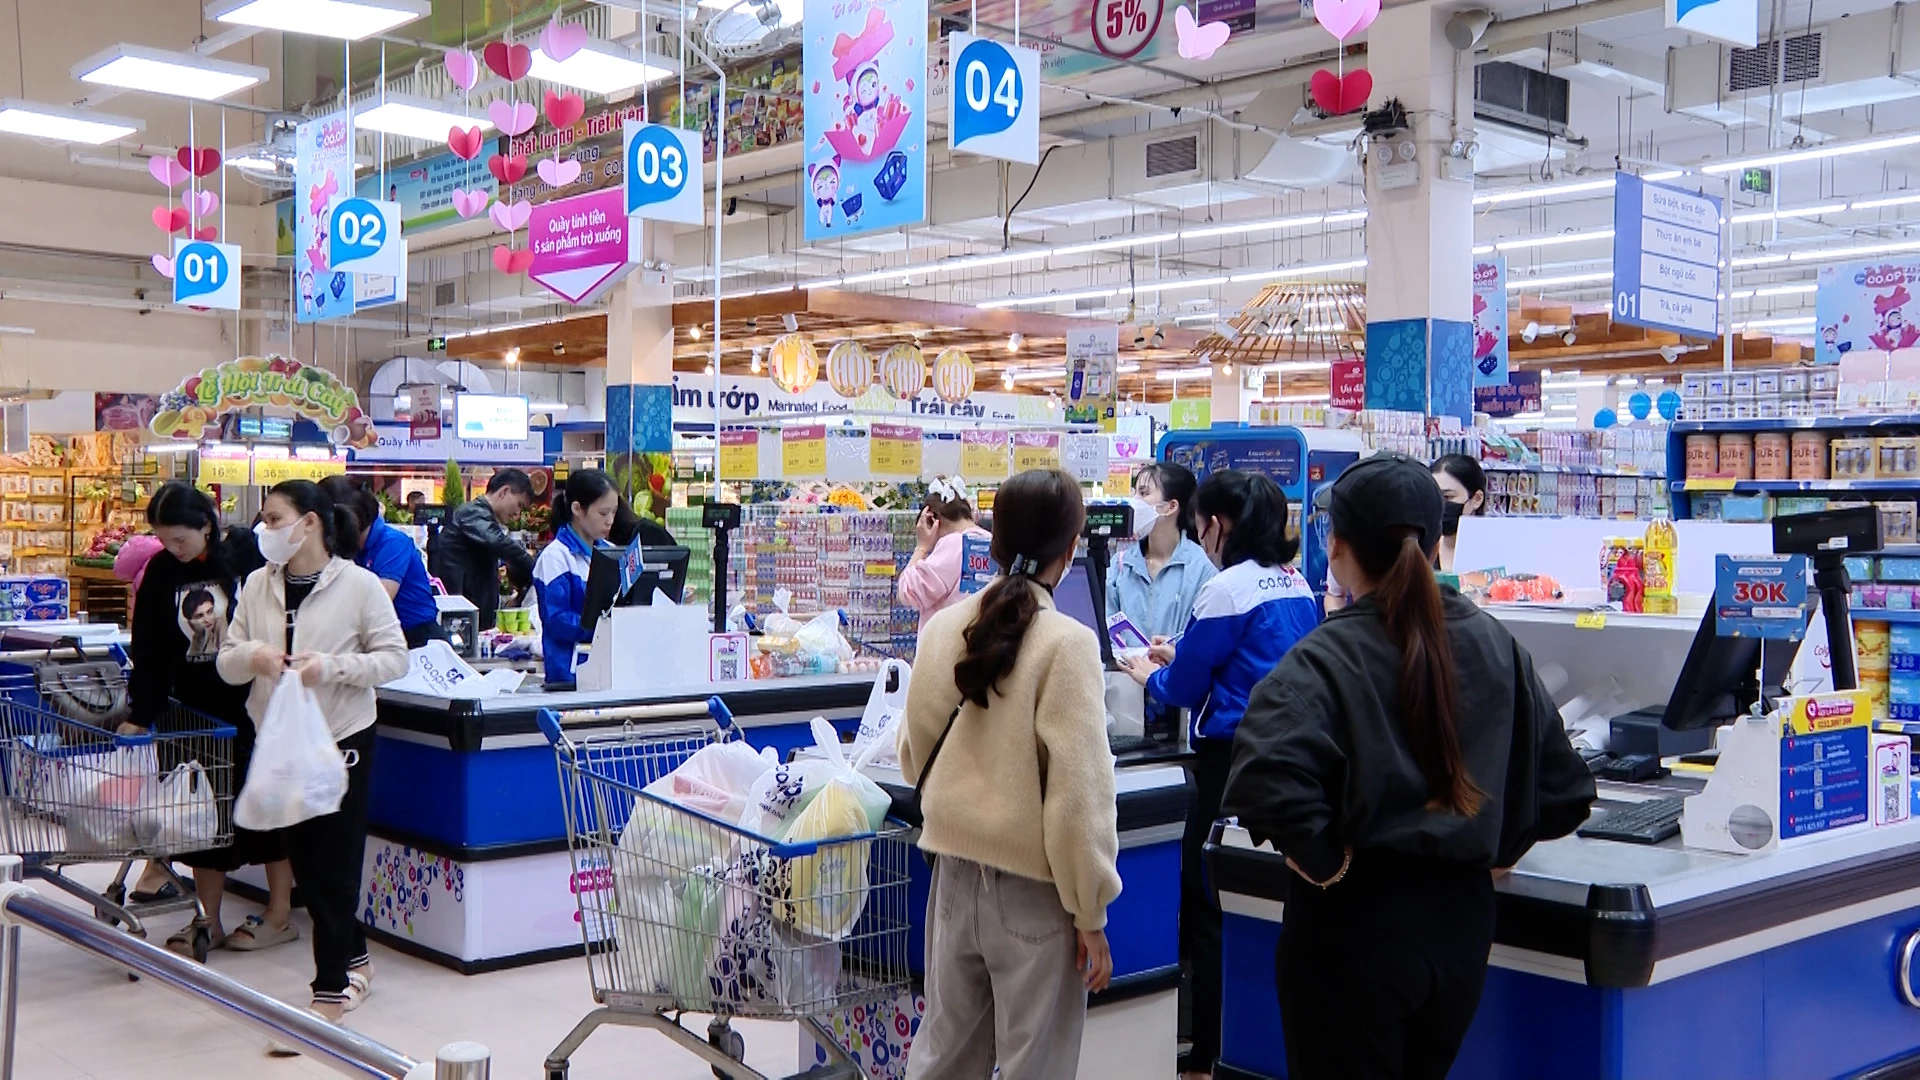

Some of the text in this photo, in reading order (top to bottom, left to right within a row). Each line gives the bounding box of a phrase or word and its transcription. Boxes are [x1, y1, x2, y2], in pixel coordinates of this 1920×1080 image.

[965, 59, 1019, 118] 04
[587, 110, 611, 137] Tiết
[636, 141, 684, 189] 03
[338, 210, 382, 248] 02
[548, 207, 606, 233] Quầy tính tiền
[540, 237, 555, 254] sản
[556, 231, 580, 254] phẩm
[581, 229, 594, 246] trở
[594, 224, 622, 245] xuống
[183, 253, 218, 284] 01
[1617, 291, 1636, 318] 01
[940, 352, 973, 398] CÂY
[672, 375, 760, 416] ẩm ướp
[911, 397, 946, 416] Trái
[378, 435, 403, 451] Quầy
[968, 554, 990, 570] 30K
[1733, 581, 1788, 603] 30K
